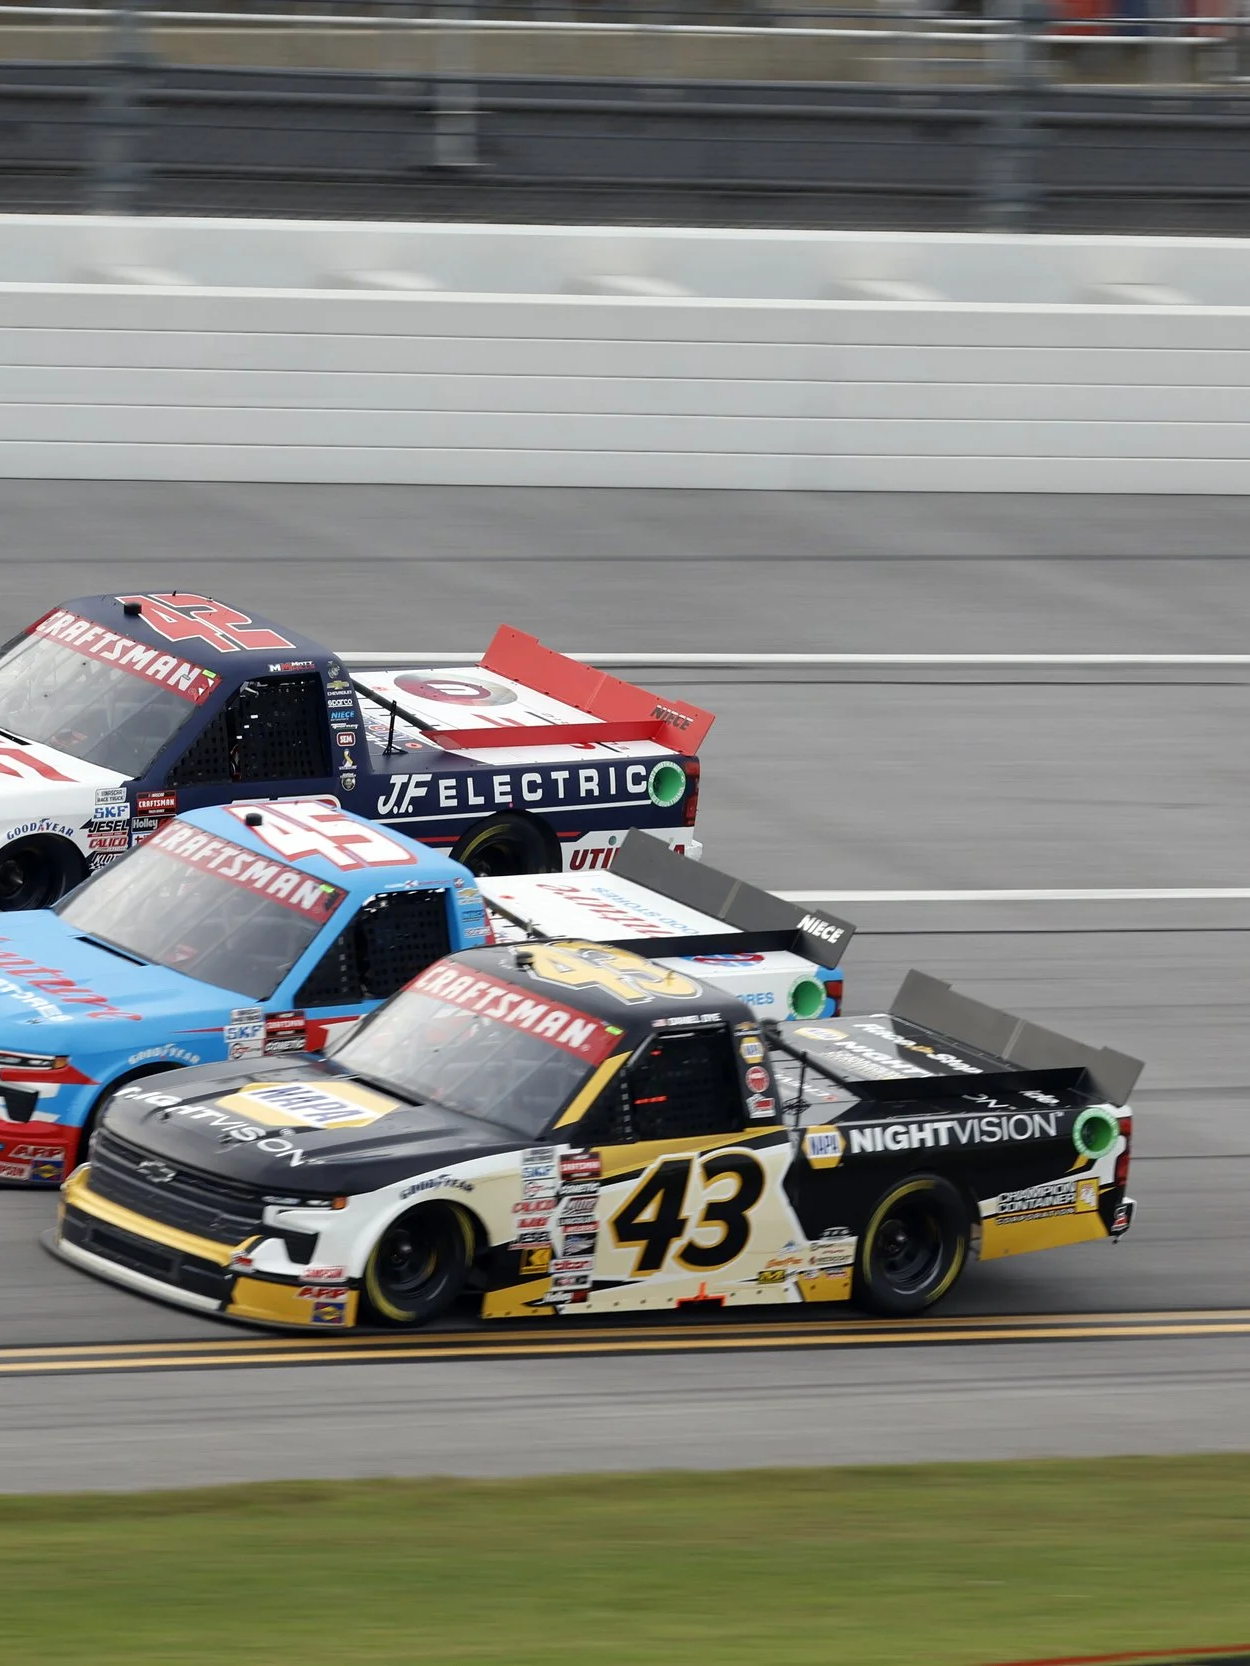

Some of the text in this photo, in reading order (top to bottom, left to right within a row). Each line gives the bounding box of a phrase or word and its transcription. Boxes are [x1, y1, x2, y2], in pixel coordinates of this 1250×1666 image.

[115, 593, 297, 653] 42
[35, 611, 202, 693] CRAFTSMAN
[331, 711, 355, 720] NIECE
[649, 704, 695, 732] NIECE
[438, 763, 647, 808] ELECTRIC
[93, 805, 129, 819] SKF
[138, 799, 175, 808] CRAFTSMAN
[6, 817, 75, 841] GOODYEAR
[88, 820, 128, 834] JESEL
[133, 818, 159, 830] Holley
[223, 800, 418, 872] 45
[88, 838, 129, 850] CALICO
[93, 853, 123, 865] KLOT
[151, 822, 325, 912] CRAFTSMAN
[796, 914, 845, 945] NIECE
[506, 939, 703, 1005] 43
[415, 964, 598, 1049] CRAFTSMAN
[226, 1025, 263, 1040] SKF
[248, 1083, 367, 1124] NAPA
[808, 1113, 1058, 1156] NAPA NIGHTVISION
[996, 1192, 1077, 1215] CONTAINER
[998, 1181, 1077, 1204] CHAMPION
[611, 1152, 767, 1274] 43
